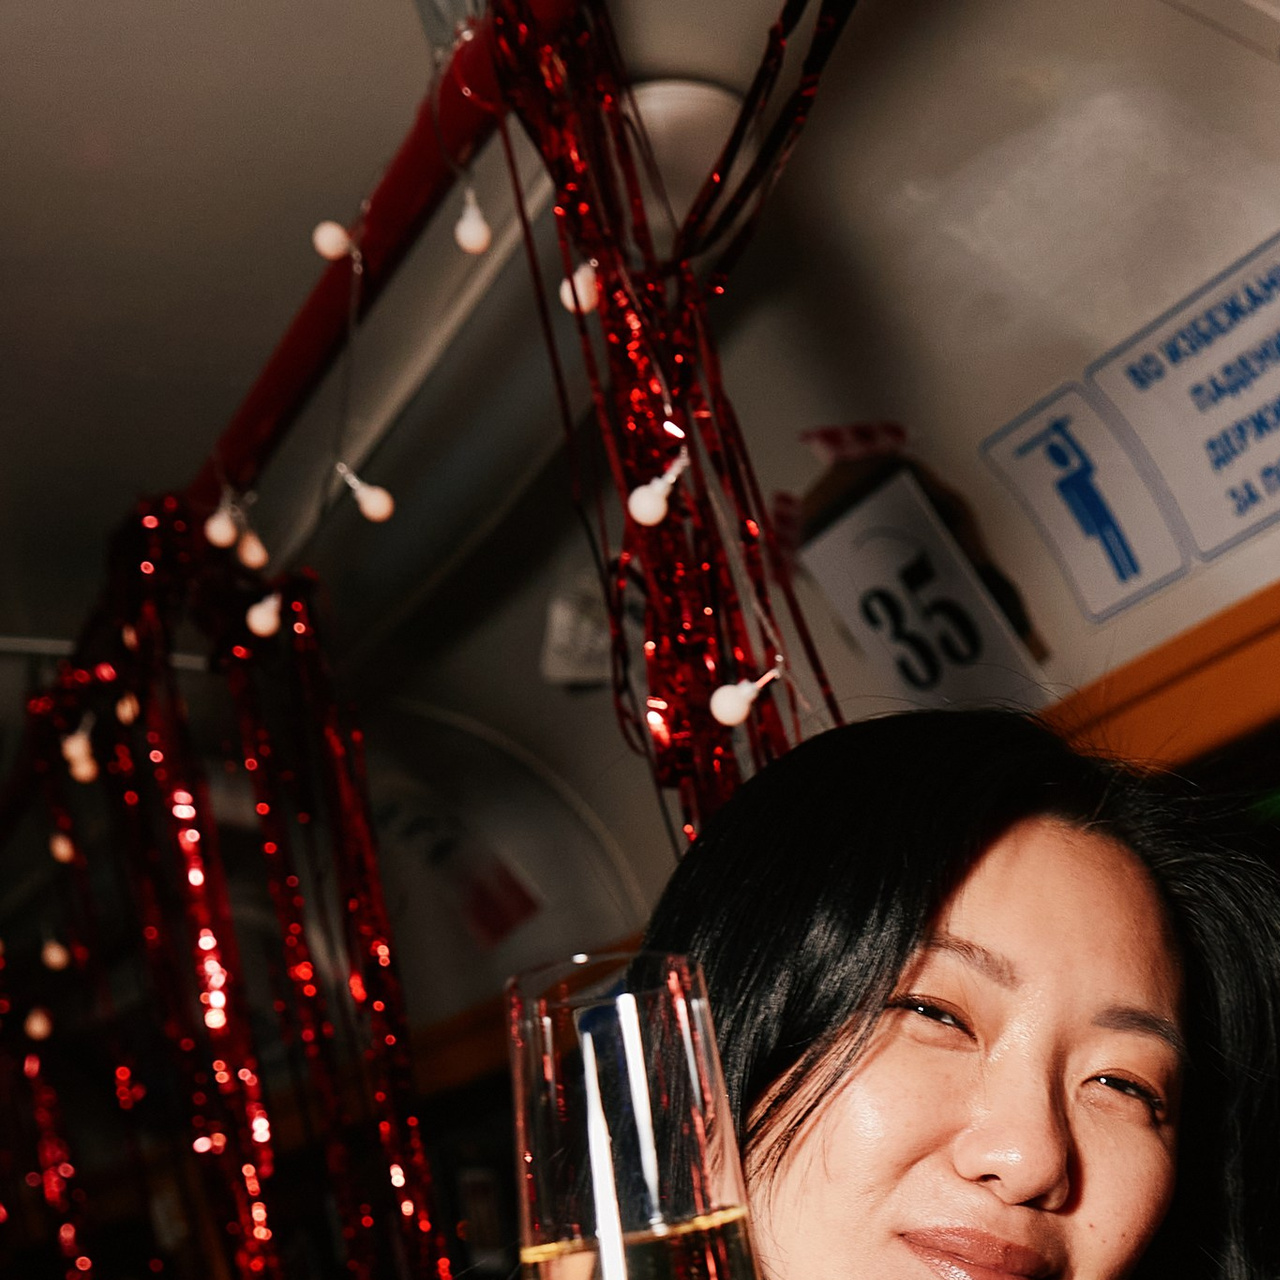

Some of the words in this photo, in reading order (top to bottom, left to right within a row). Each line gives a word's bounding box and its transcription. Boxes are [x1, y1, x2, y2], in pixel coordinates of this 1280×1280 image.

[1126, 355, 1165, 391] ВО
[1226, 482, 1259, 516] ЗА
[860, 554, 981, 689] 35
